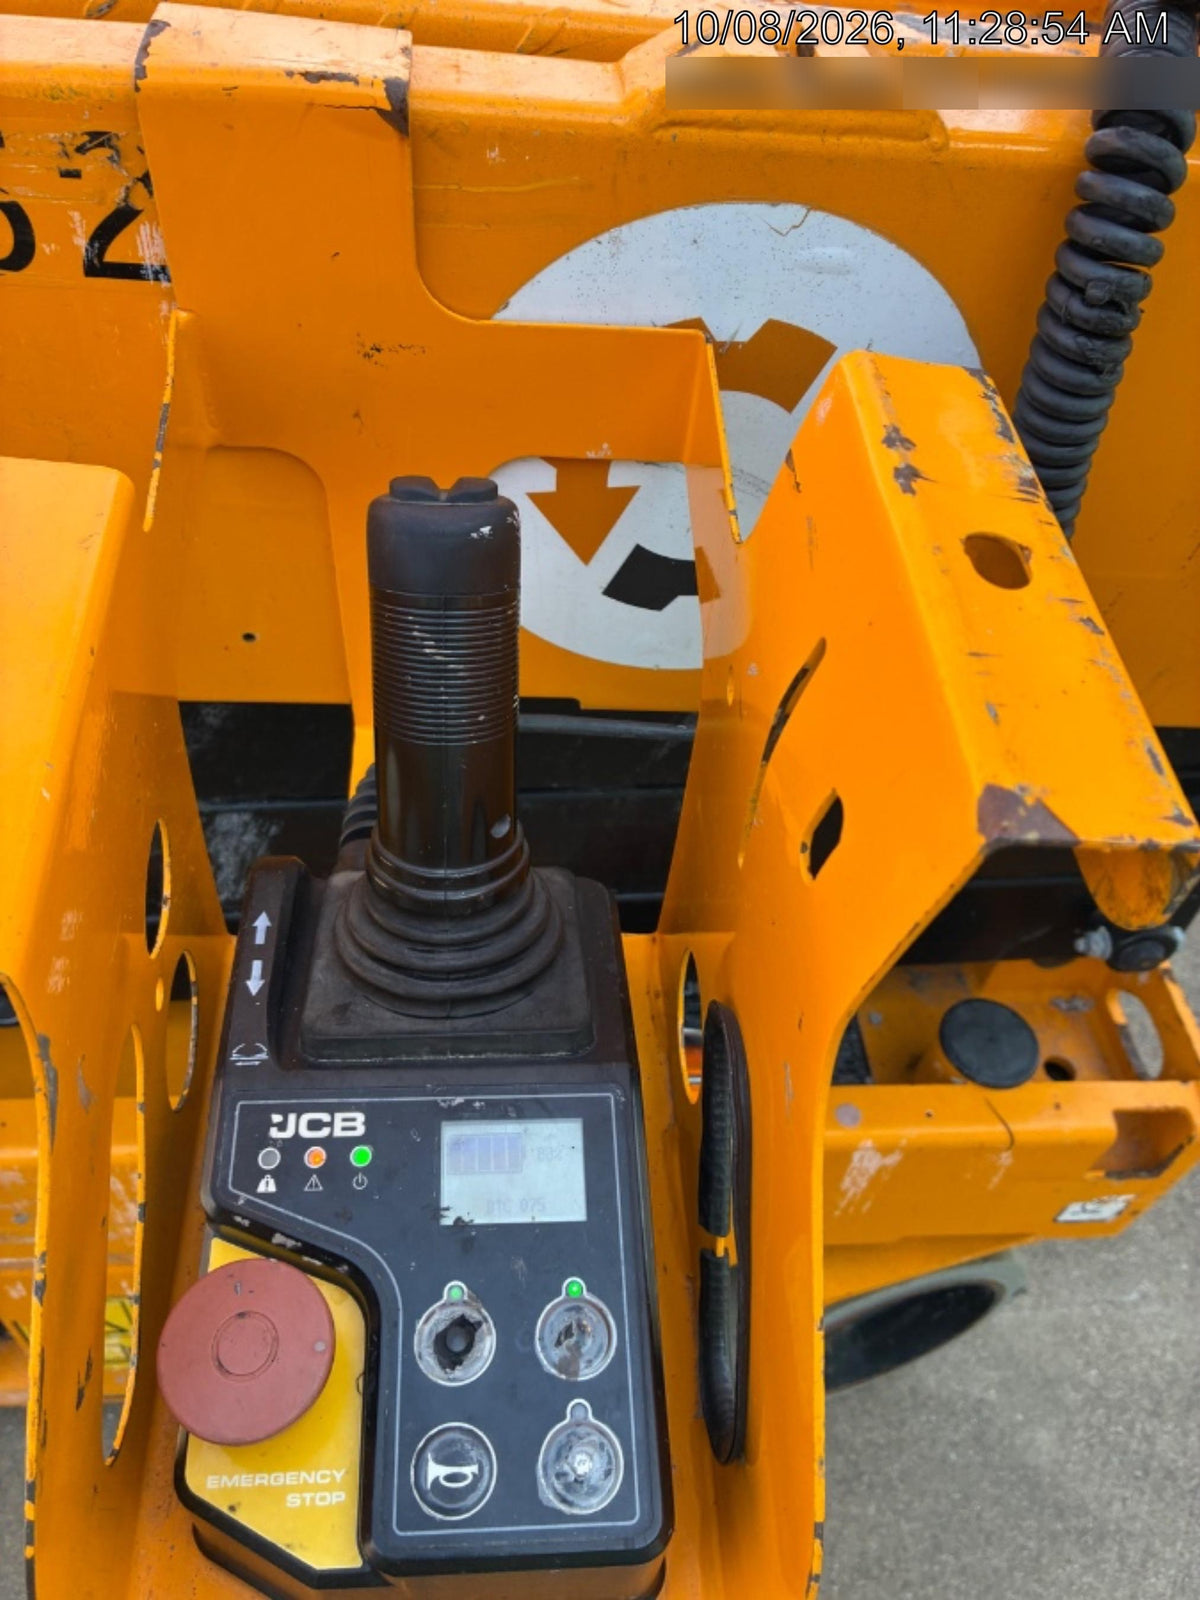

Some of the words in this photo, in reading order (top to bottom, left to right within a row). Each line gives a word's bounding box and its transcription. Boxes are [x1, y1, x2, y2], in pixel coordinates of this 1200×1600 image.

[269, 1112, 366, 1138] JCB
[206, 1469, 346, 1489] EMERGENCY
[285, 1491, 346, 1508] STOP
